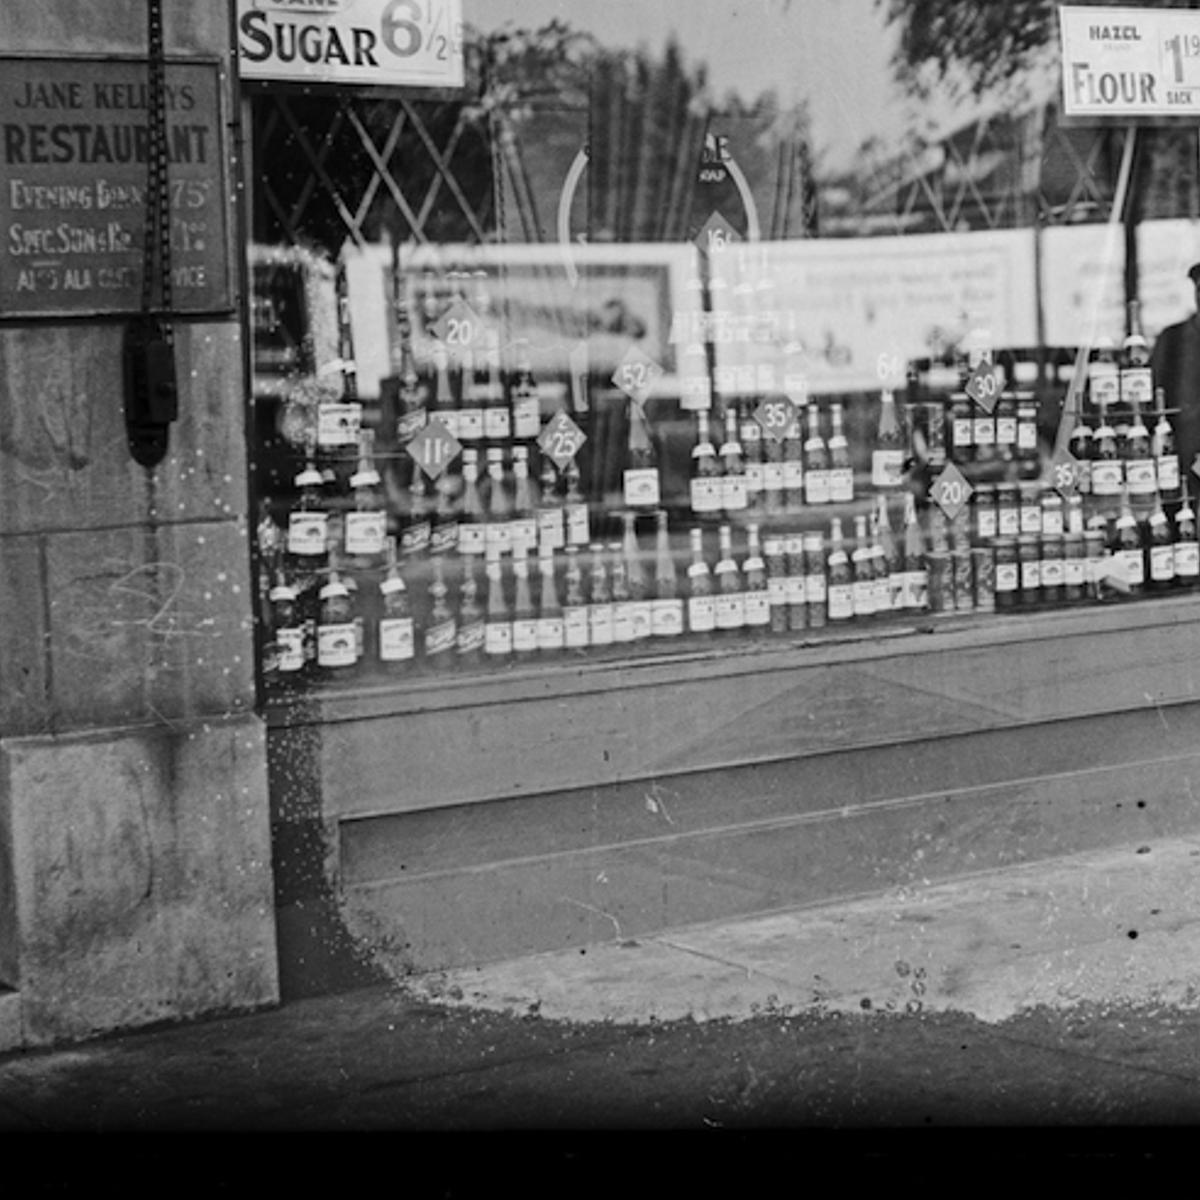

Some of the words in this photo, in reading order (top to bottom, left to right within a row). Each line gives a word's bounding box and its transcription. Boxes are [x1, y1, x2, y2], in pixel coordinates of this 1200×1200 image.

[239, 10, 380, 67] SUGAR
[14, 82, 83, 109] JANE
[1072, 61, 1157, 105] FLOUR
